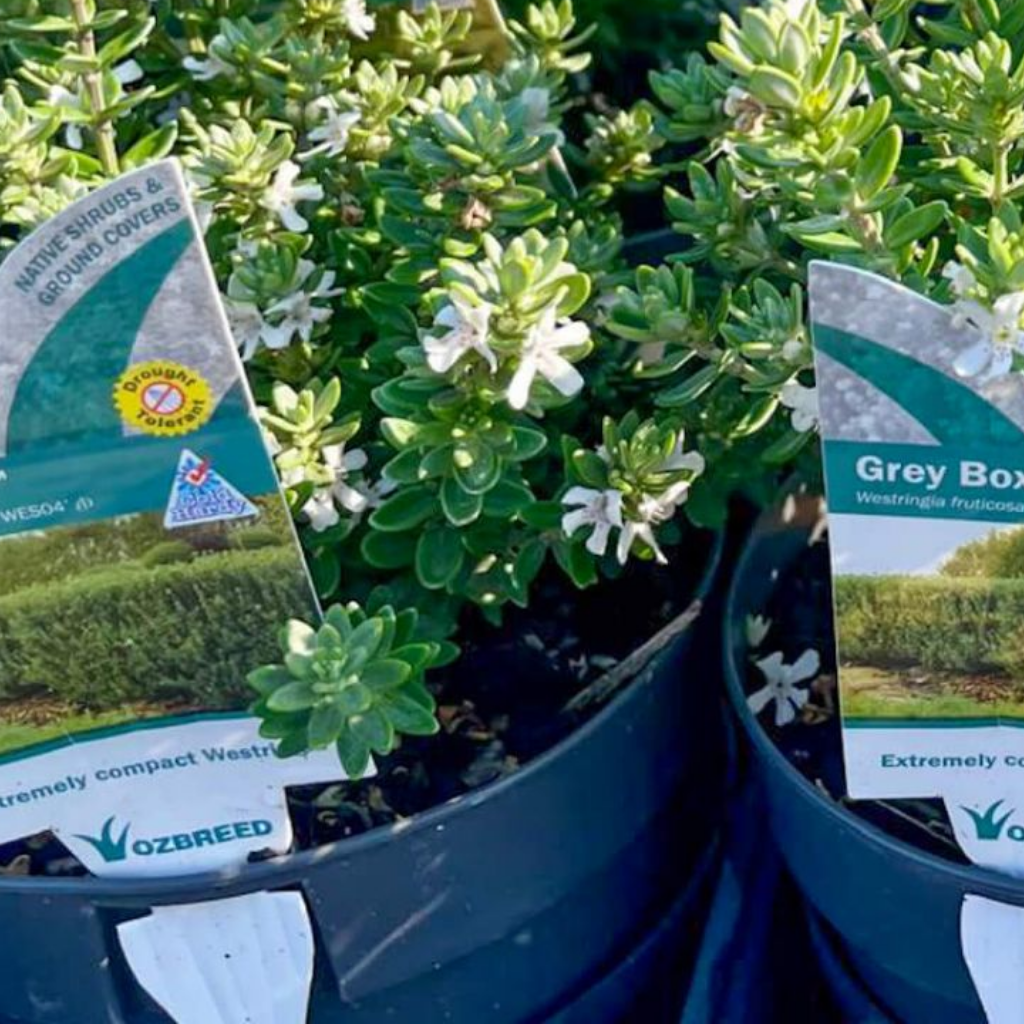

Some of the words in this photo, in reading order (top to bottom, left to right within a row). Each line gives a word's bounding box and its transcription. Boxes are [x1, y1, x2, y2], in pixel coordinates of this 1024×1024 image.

[14, 236, 69, 294] NATIVE
[65, 187, 142, 241] SHRUBS
[146, 177, 164, 194] &
[37, 243, 102, 307] GROUND
[104, 197, 181, 246] COVERS
[122, 367, 197, 393] Drought
[136, 399, 206, 428] Tolerant
[855, 454, 947, 491] Grey
[856, 490, 946, 509] Westringia
[94, 752, 198, 784] compact
[200, 743, 280, 762] Westri
[879, 752, 998, 770] Extremely
[131, 818, 273, 857] OZBREED
